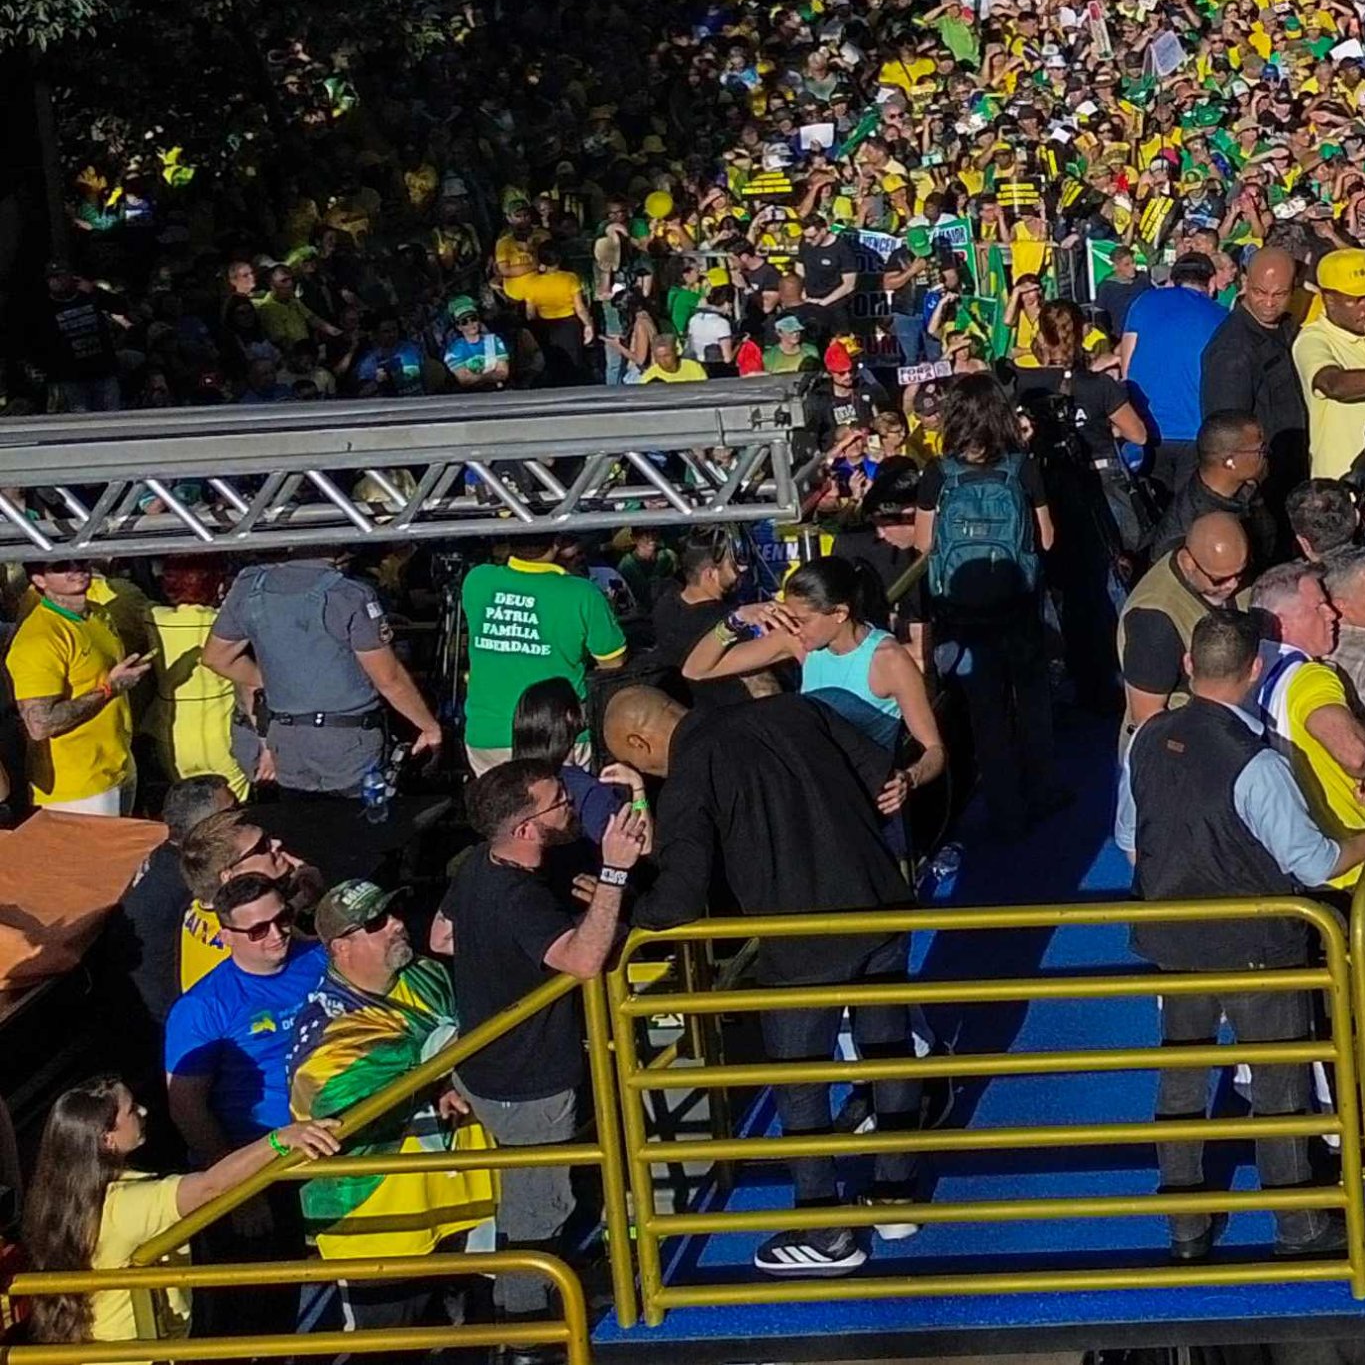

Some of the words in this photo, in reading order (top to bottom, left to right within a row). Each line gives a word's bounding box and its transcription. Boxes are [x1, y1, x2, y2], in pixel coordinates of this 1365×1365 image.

[494, 591, 536, 609] DEUS
[485, 606, 539, 625] PÁTRIA
[483, 622, 540, 641] FAMÍLIA
[474, 636, 551, 656] LIBERDADE
